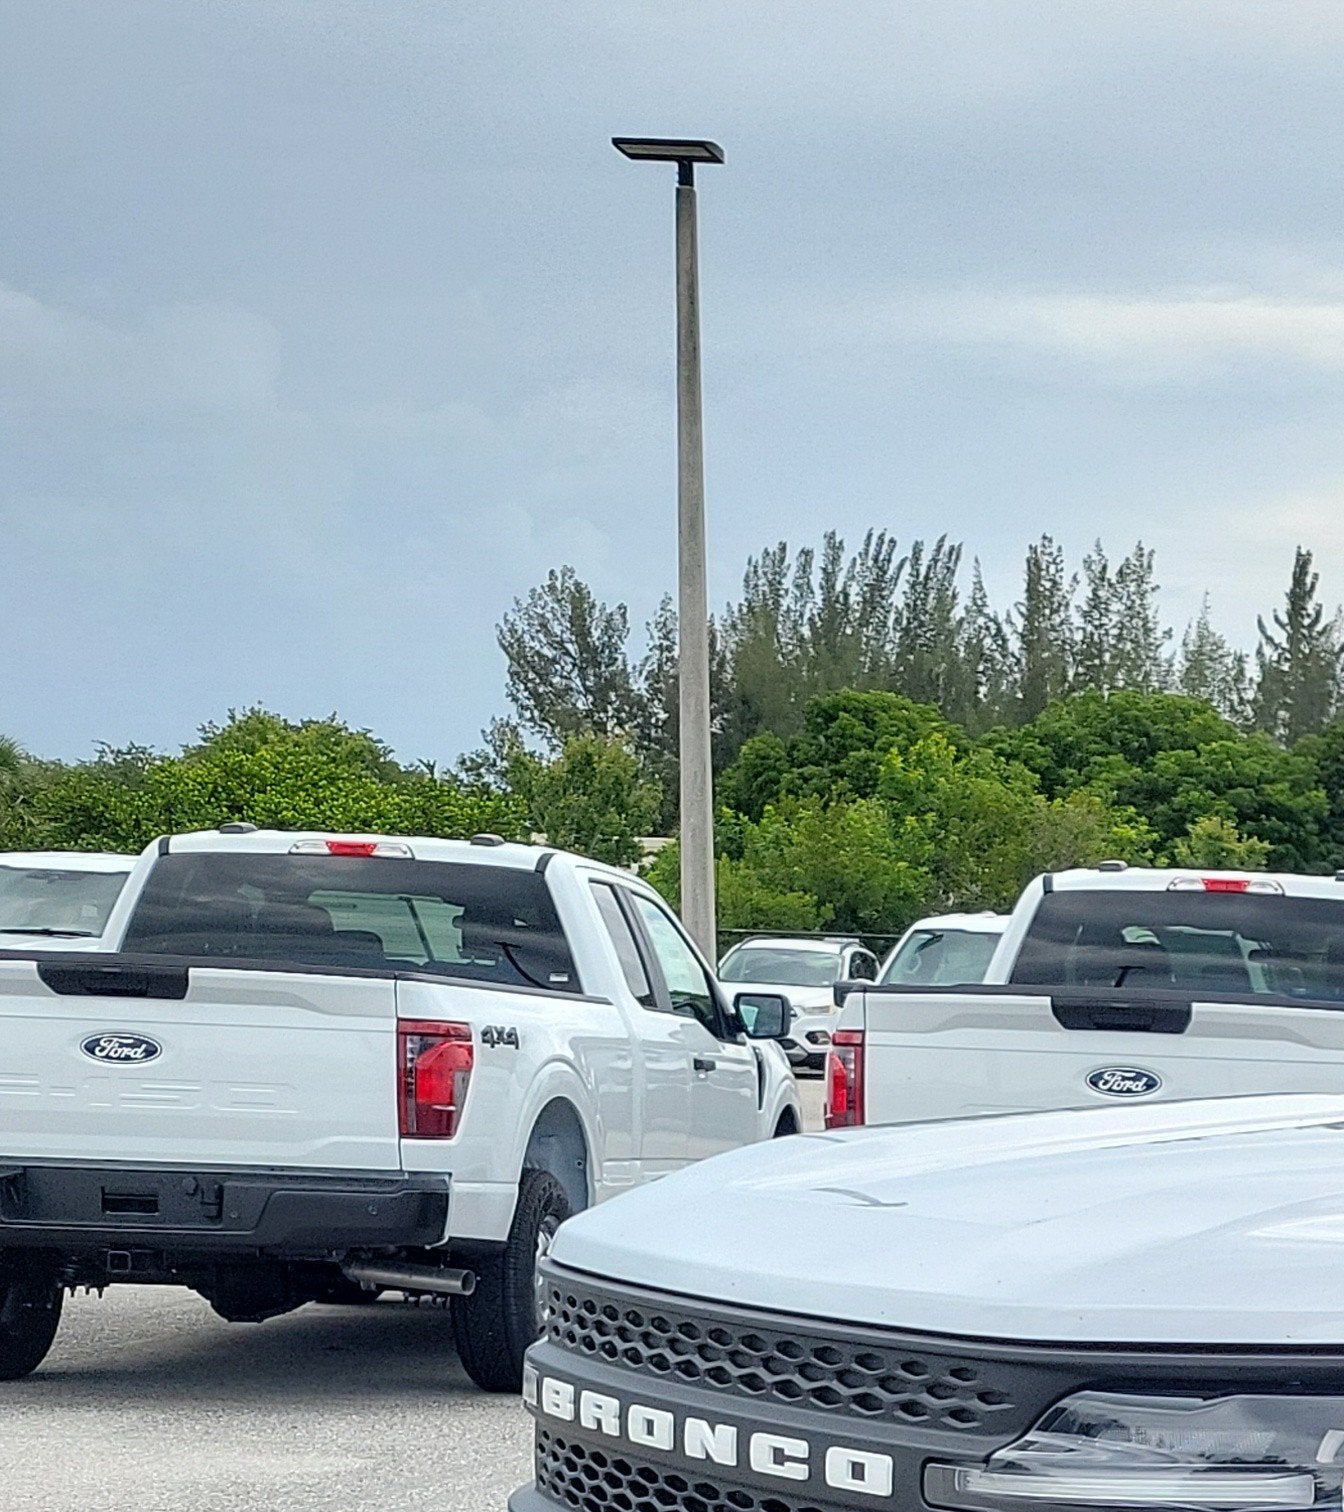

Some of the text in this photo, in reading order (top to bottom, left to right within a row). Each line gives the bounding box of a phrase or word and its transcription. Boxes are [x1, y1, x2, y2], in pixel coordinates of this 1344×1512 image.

[94, 1036, 147, 1059] Ford
[1098, 1070, 1149, 1092] Ford
[540, 1376, 894, 1498] BRONCO
